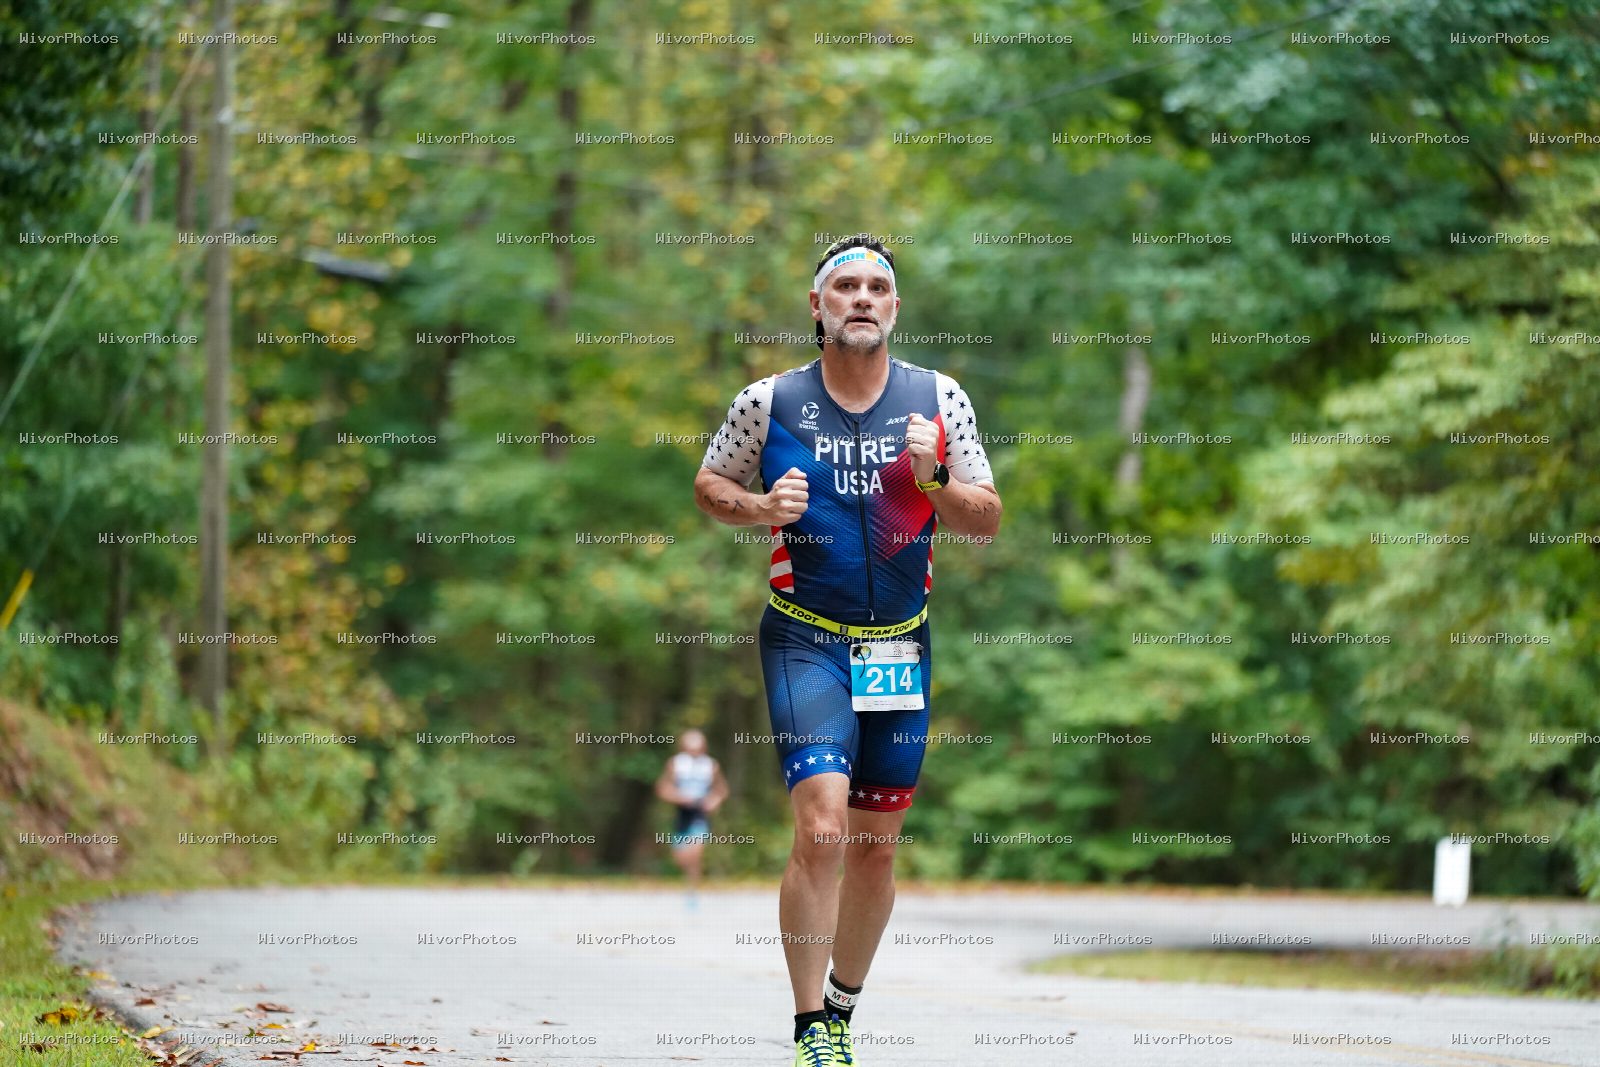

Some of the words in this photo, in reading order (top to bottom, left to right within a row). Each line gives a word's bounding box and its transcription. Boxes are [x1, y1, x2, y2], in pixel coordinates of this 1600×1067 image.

[815, 436, 898, 466] PITRE
[834, 469, 884, 496] USA
[772, 595, 791, 611] TEAM
[791, 608, 819, 623] ZOOT
[861, 627, 892, 638] TEAM
[893, 620, 914, 634] ZOOT
[866, 665, 913, 694] 214
